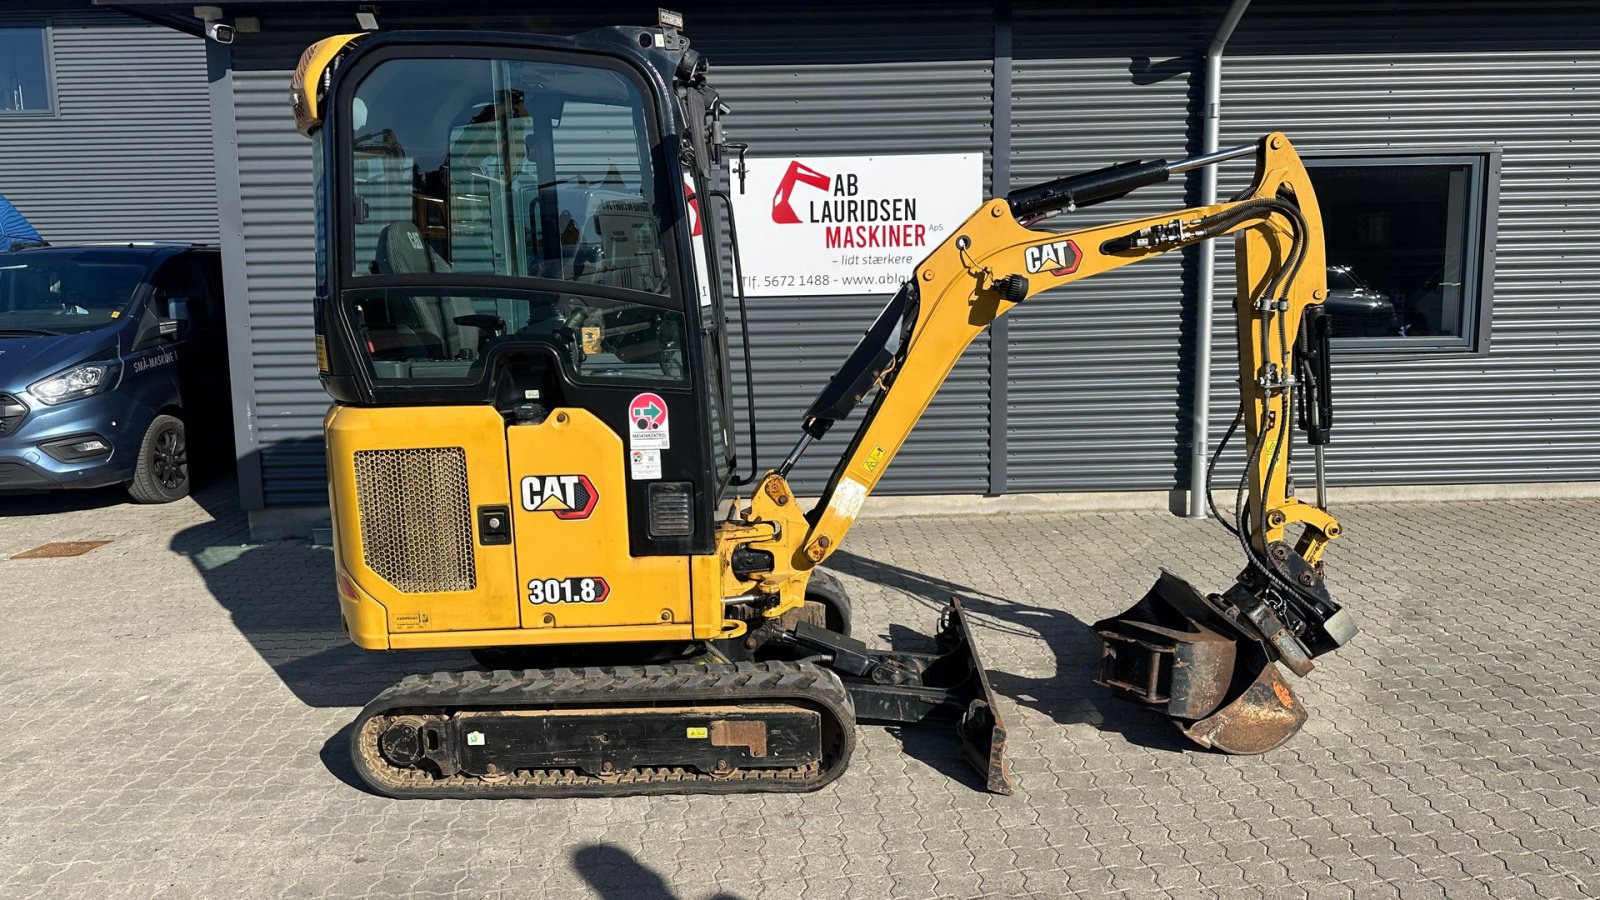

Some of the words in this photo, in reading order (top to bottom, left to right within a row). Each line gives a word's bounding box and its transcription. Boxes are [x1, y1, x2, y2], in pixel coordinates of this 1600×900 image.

[833, 173, 859, 197] AB
[809, 198, 917, 224] LAURIDSEN
[825, 224, 926, 249] MASKINER
[928, 223, 944, 233] ApS
[841, 253, 859, 266] lidt
[862, 253, 913, 266] stærkere
[1025, 241, 1068, 274] CAT
[741, 275, 760, 290] Tlf.
[764, 275, 795, 288] 5672
[799, 273, 830, 287] 1488
[522, 475, 579, 511] CAT
[528, 578, 596, 604] 301.8
